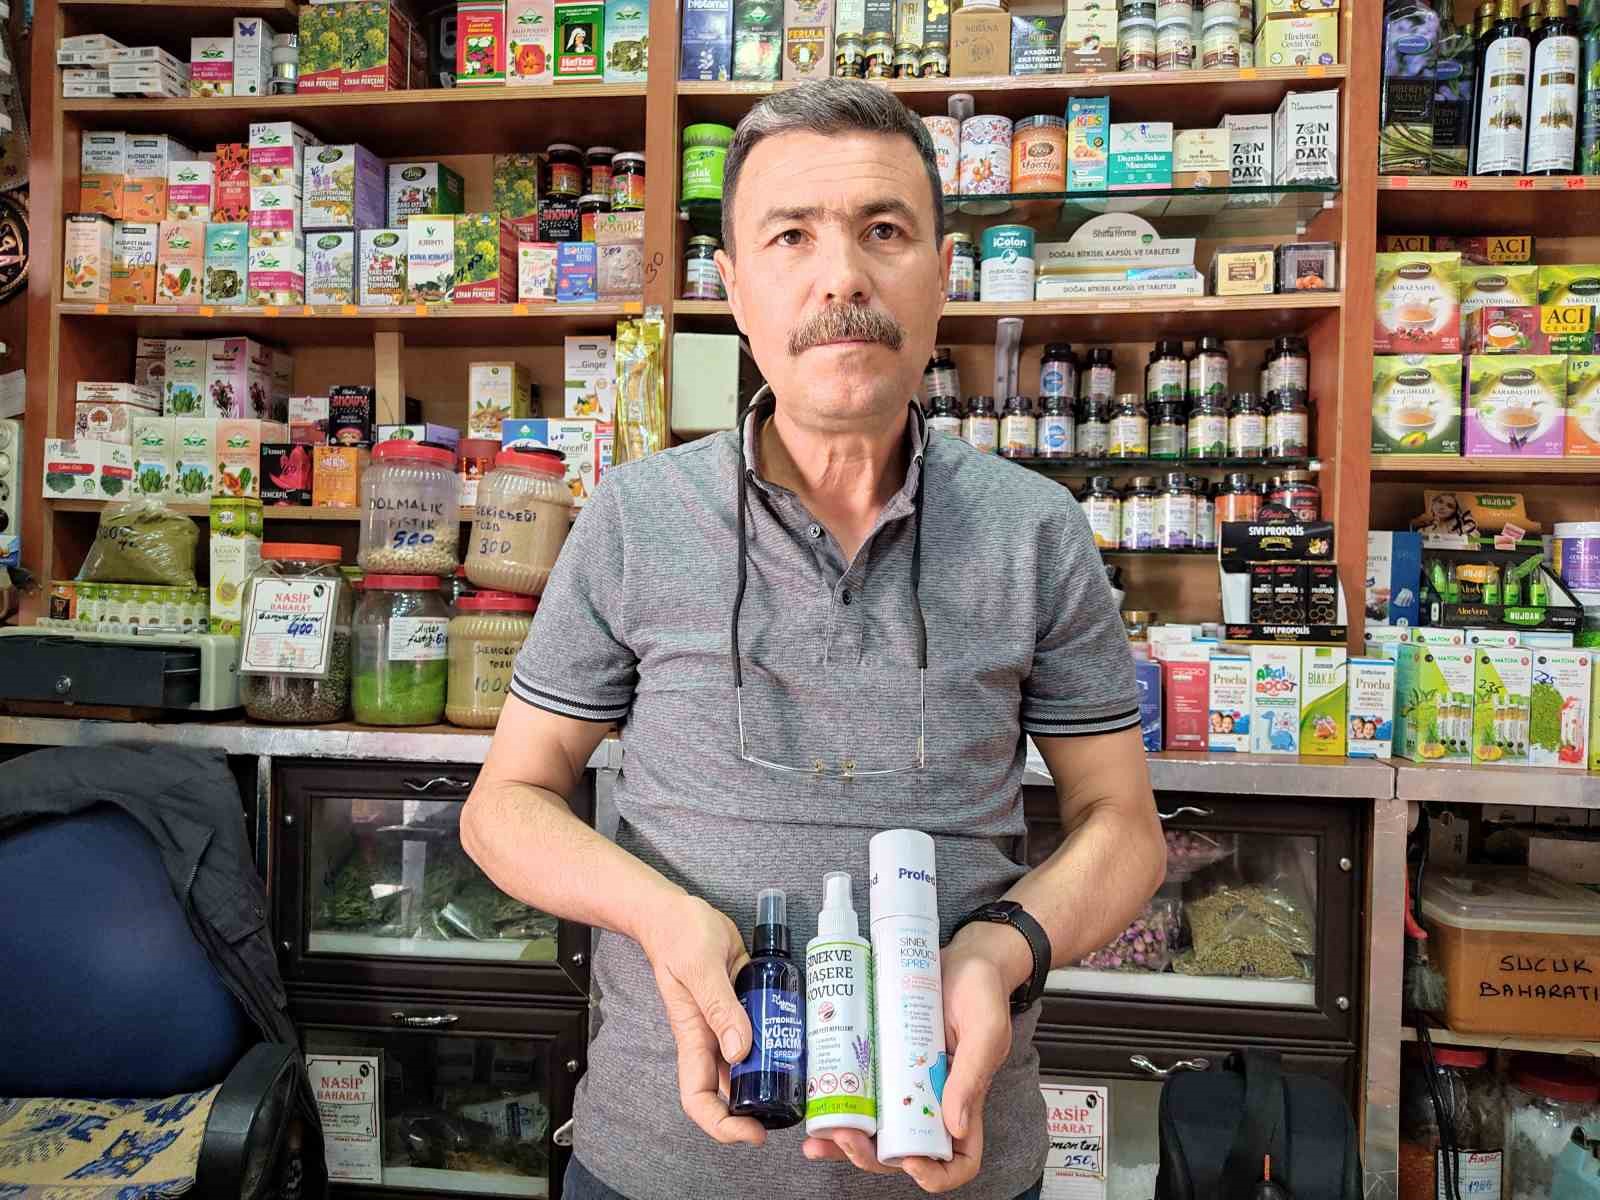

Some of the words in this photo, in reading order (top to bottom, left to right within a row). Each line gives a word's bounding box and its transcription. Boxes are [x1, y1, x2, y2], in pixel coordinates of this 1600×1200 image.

[1296, 147, 1328, 160] DAK
[1232, 166, 1263, 178] DAK
[1495, 239, 1526, 253] ACI
[1548, 308, 1585, 323] ACI
[581, 360, 607, 370] Ginger
[368, 497, 445, 516] DOLMALIK
[1265, 525, 1304, 536] PROPOLİS
[274, 591, 311, 603] NASİP
[1276, 626, 1310, 635] PROPOLİS
[1499, 954, 1593, 974] SUCUK
[1480, 981, 1599, 1001] BAHARATI
[764, 1024, 802, 1038] VÜCUT
[320, 1075, 364, 1090] NASİP
[1047, 1105, 1089, 1121] ASİP
